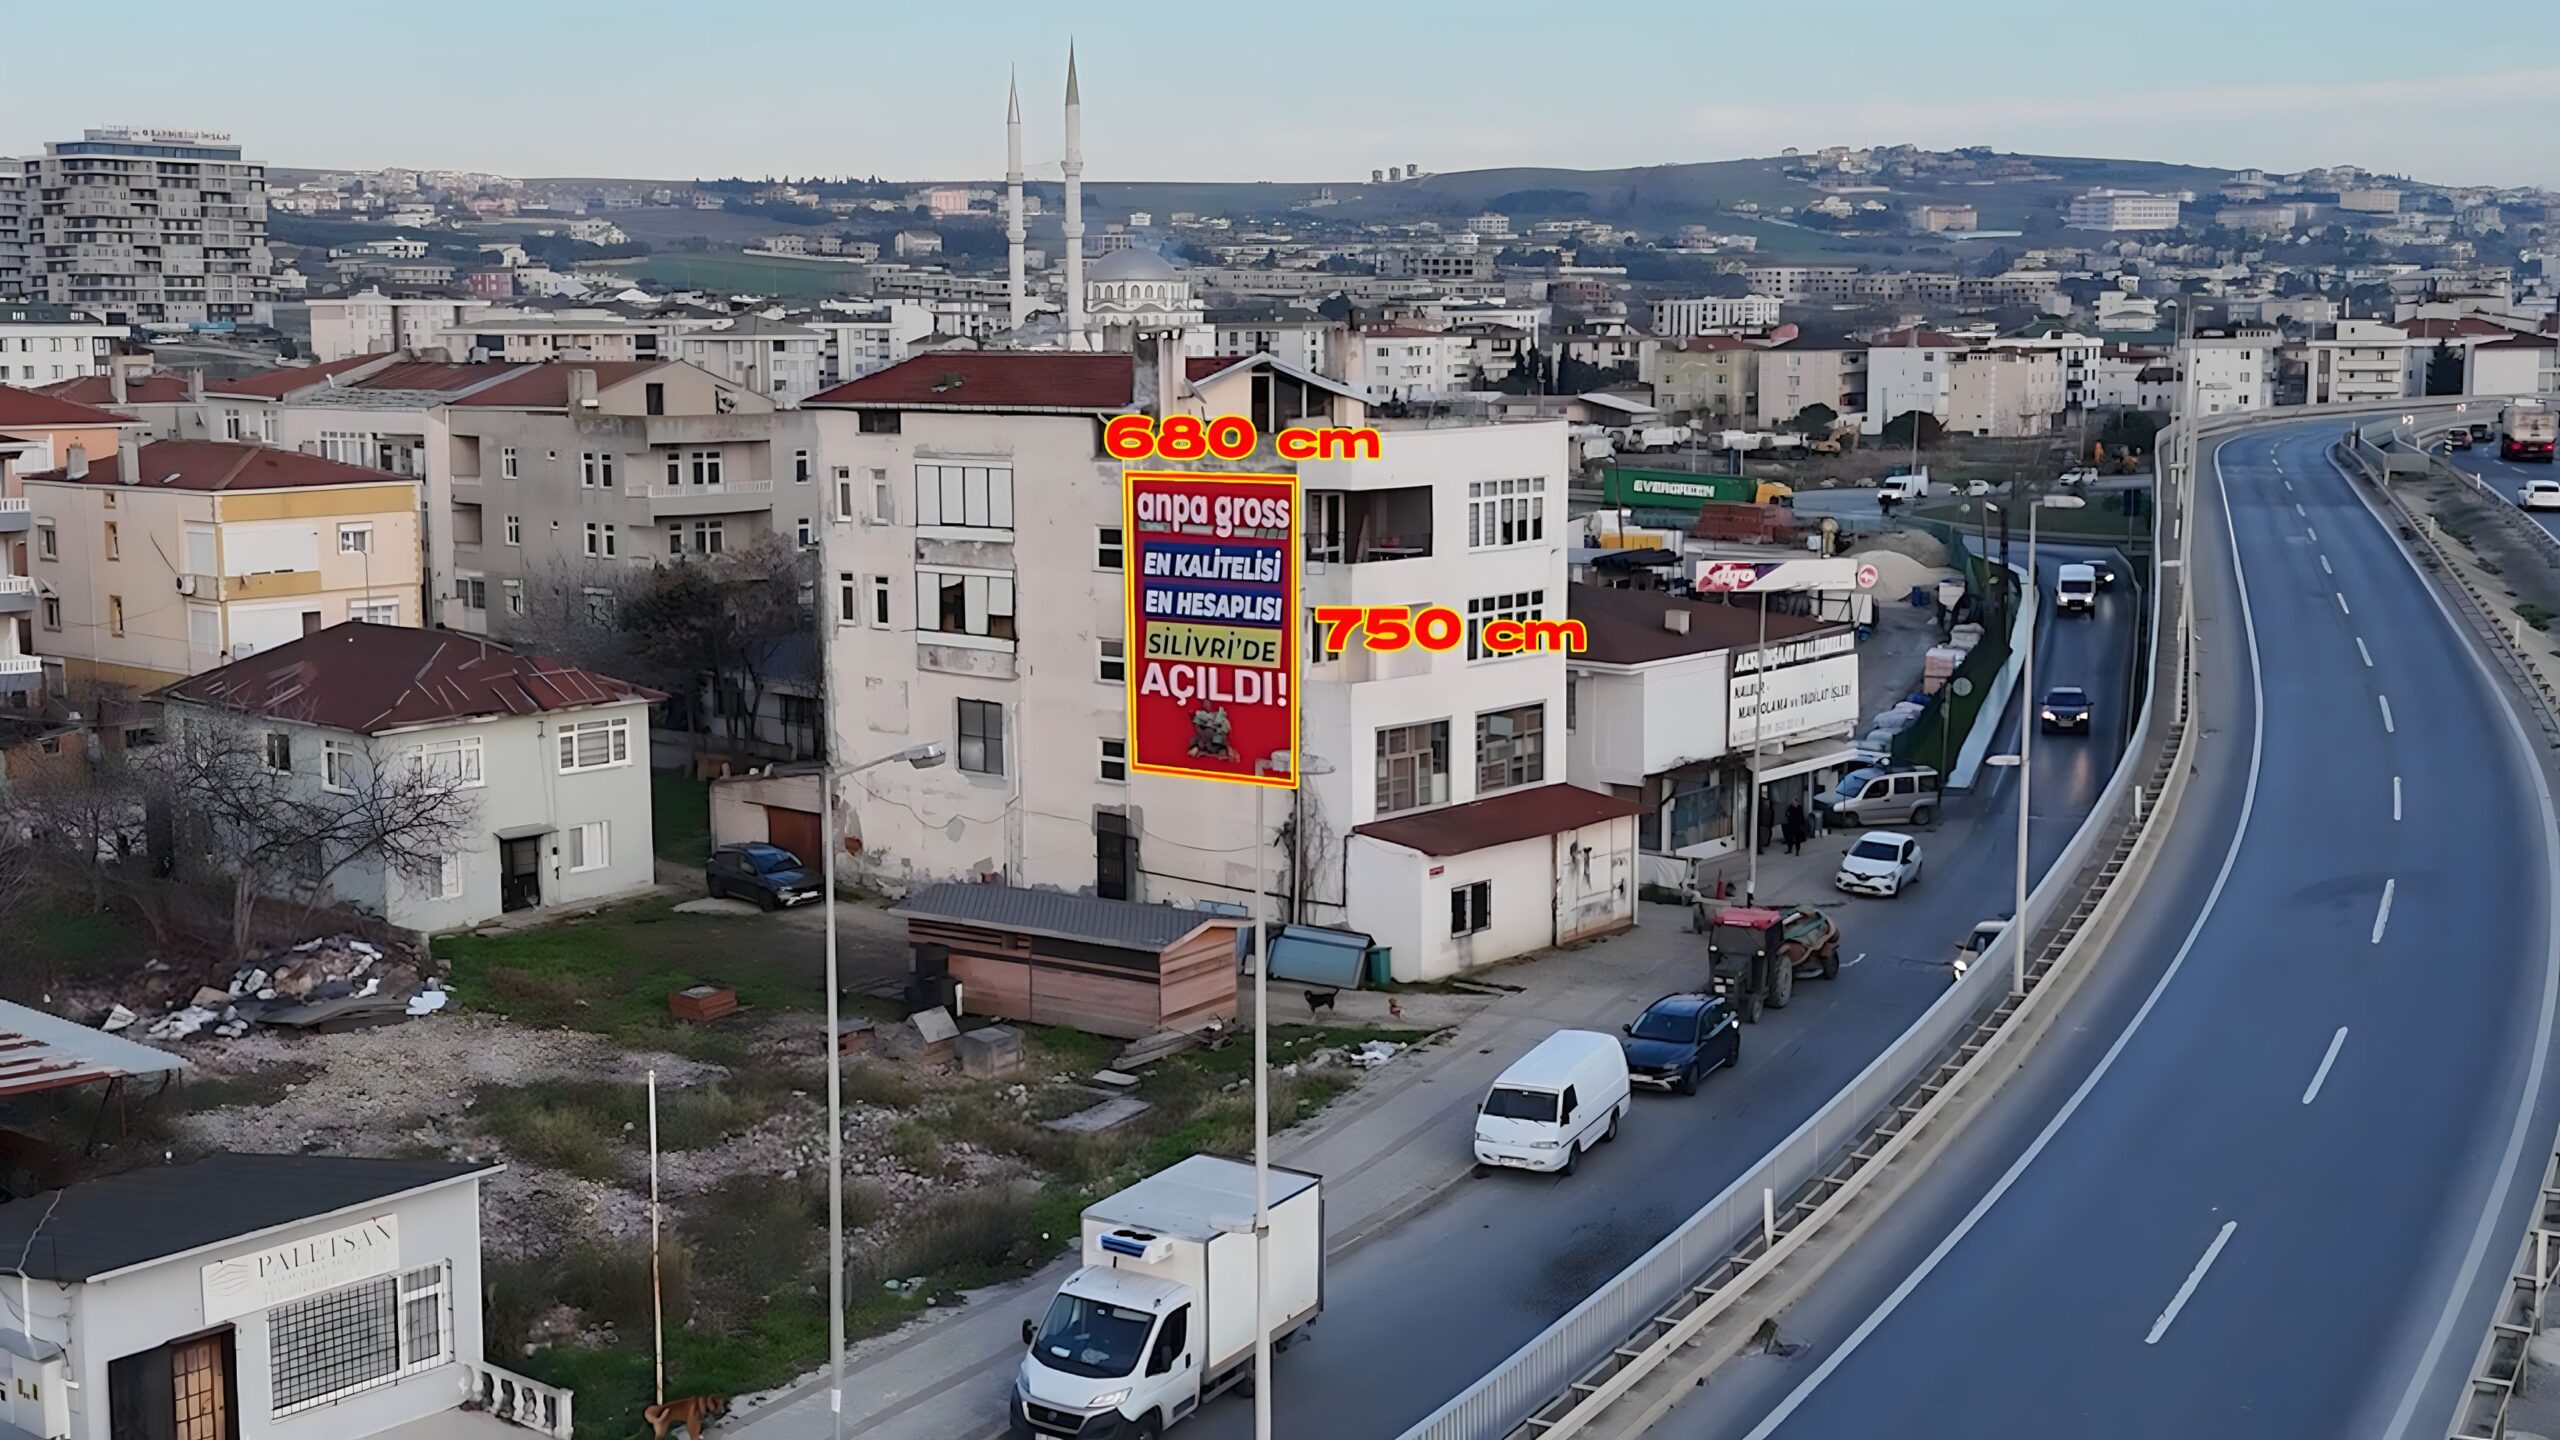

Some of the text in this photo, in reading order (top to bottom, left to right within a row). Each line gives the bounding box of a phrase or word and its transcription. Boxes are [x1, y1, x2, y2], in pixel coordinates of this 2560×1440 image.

[1137, 491, 1290, 538] anpa gross
[1144, 547, 1282, 582] EN KALİTELİSİ
[1145, 589, 1283, 622] EN HESAPLISI
[1148, 626, 1277, 662] SİLİVRİ'DE
[1140, 662, 1288, 707] AÇILDI!
